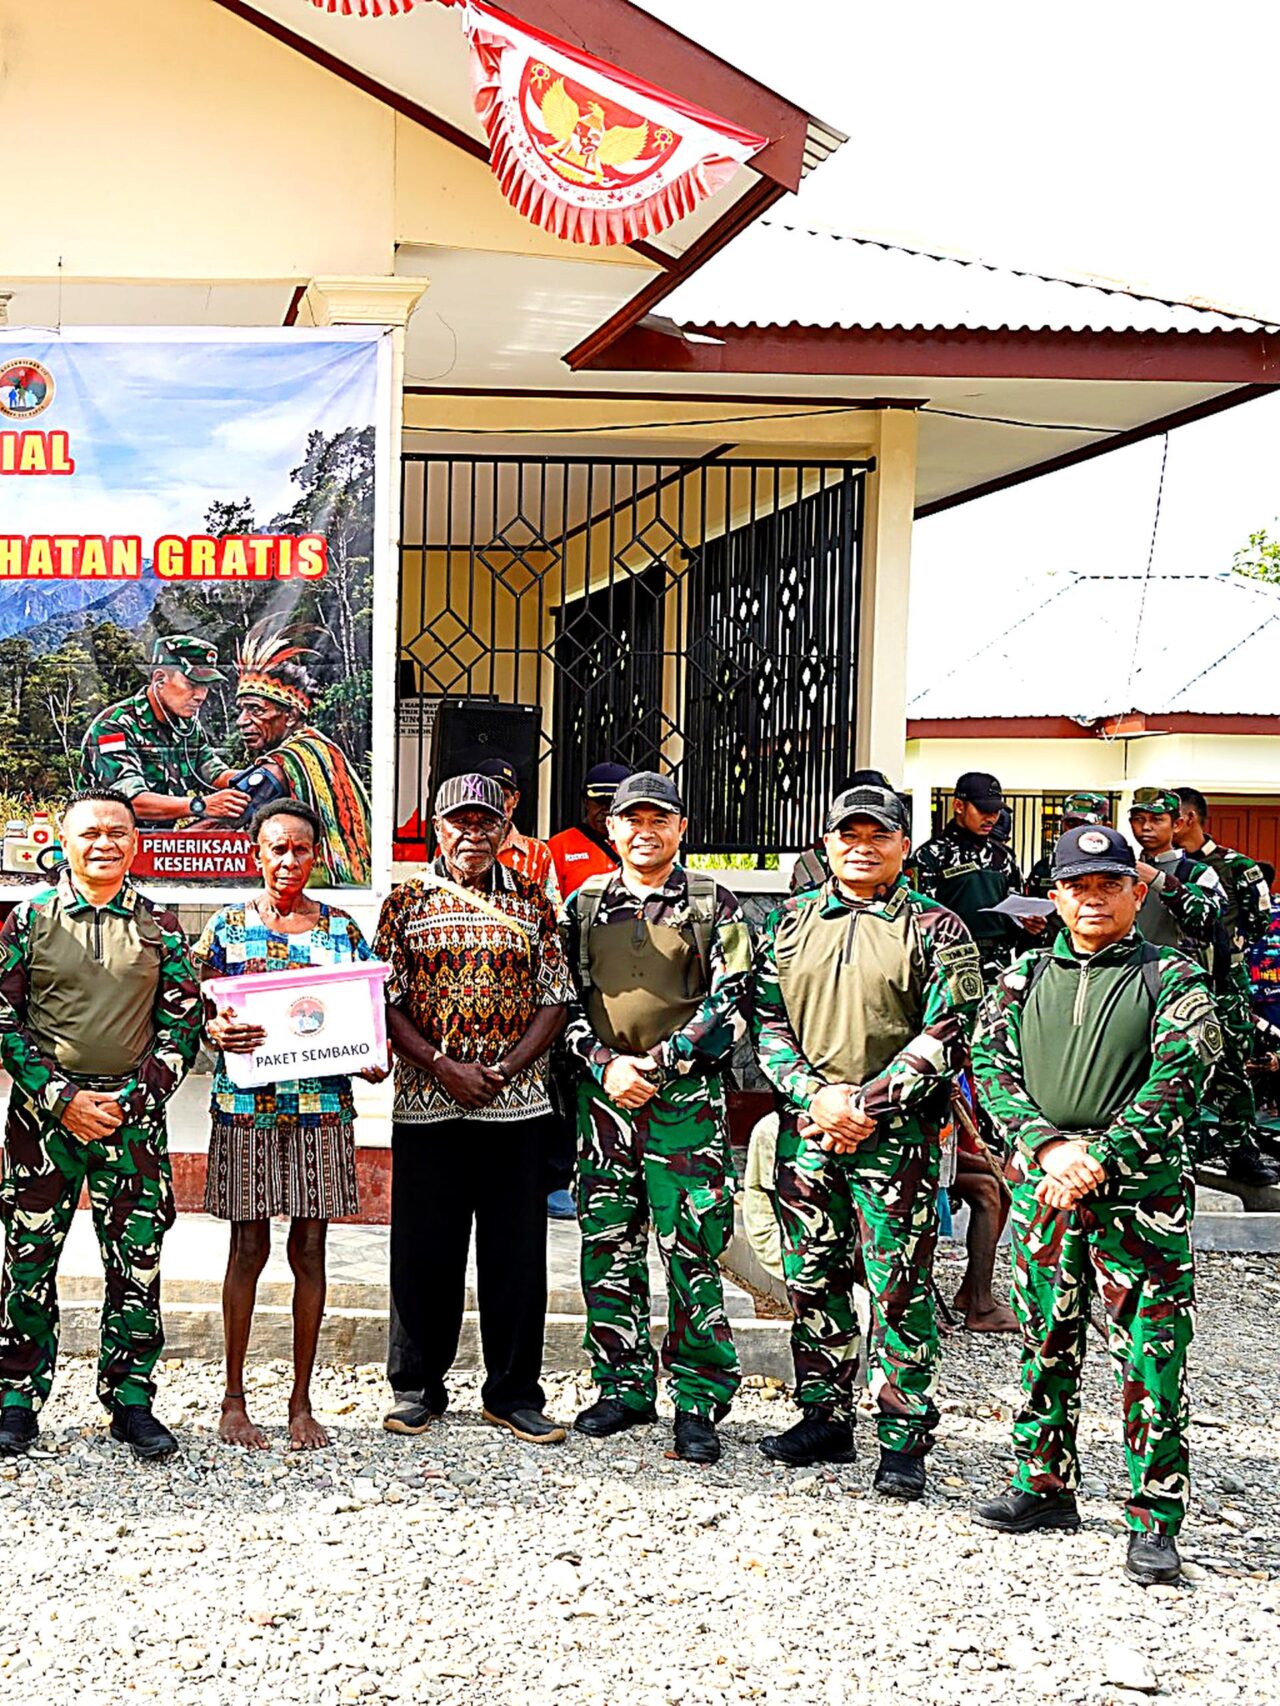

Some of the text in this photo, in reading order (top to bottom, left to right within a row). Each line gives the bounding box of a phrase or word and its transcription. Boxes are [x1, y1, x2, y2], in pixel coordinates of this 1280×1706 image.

[156, 538, 326, 578] GRATIS
[153, 856, 247, 872] KESEHATAN
[256, 1042, 370, 1068] PAKET SEMBAKO
